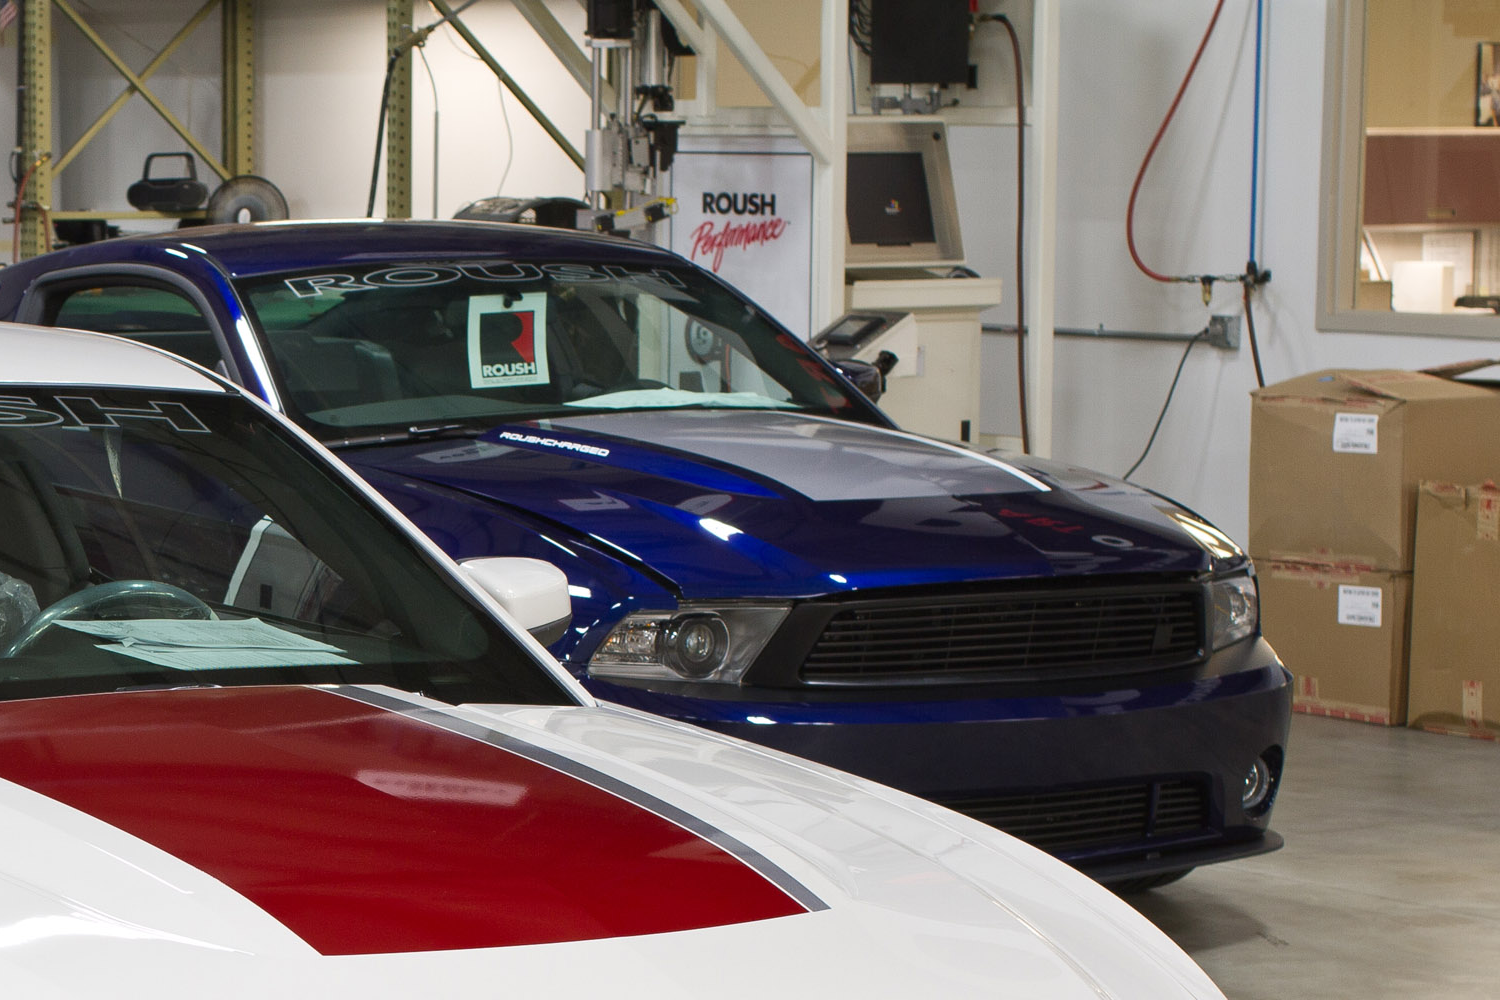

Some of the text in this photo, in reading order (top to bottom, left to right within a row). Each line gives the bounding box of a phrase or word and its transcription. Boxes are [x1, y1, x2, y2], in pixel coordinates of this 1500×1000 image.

[703, 192, 776, 216] ROUSH
[690, 217, 787, 273] Performance
[283, 263, 688, 298] ROUSH
[482, 362, 536, 377] ROUSH
[500, 431, 610, 457] ROUSHCHARGED
